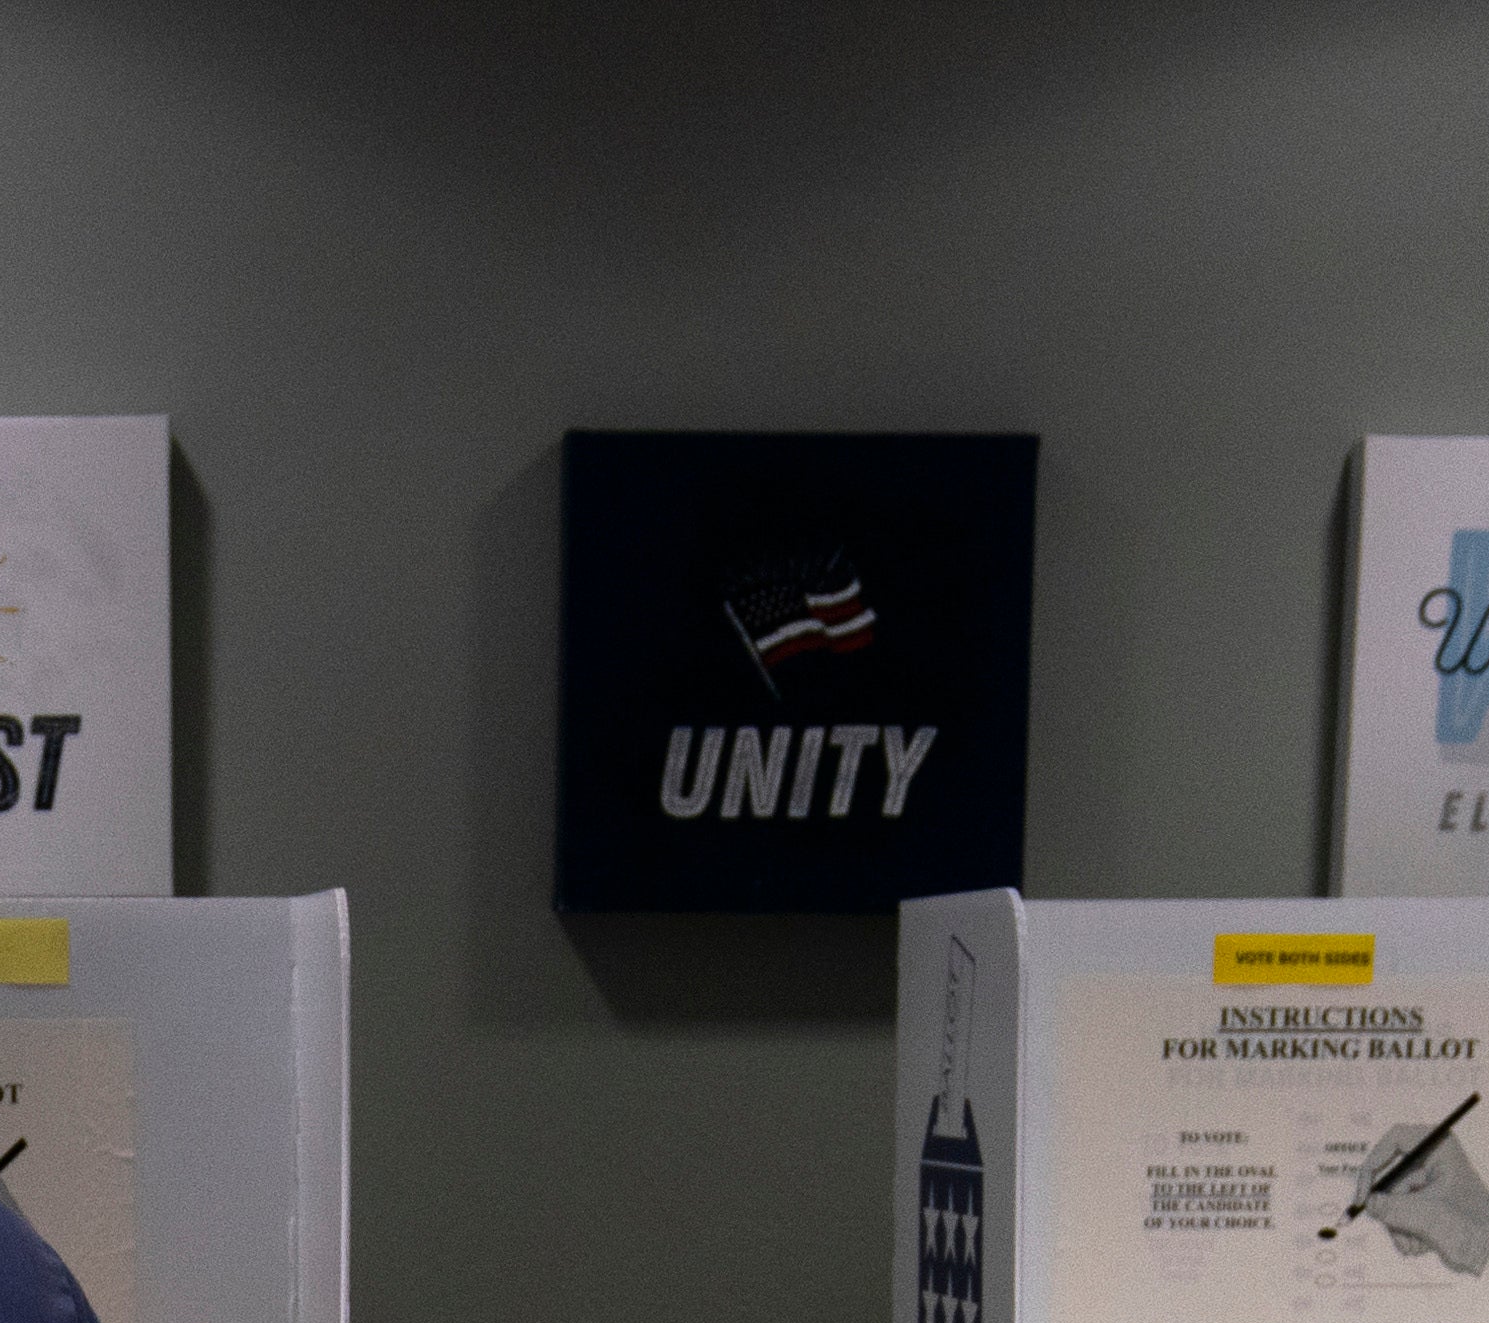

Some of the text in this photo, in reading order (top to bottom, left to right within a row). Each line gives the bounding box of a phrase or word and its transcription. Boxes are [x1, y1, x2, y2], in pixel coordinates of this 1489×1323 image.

[660, 724, 938, 819] UNITY
[1235, 951, 1370, 967] VOTE BOTH SIDES
[1218, 1005, 1424, 1033] INSTRUCTIONS
[1163, 1037, 1479, 1060] FOR MARKING BALLOT
[1179, 1131, 1200, 1144] TO
[1146, 1165, 1278, 1179] FILL IN THE OVAL
[1152, 1182, 1271, 1197] TO THE LEFT OF
[1152, 1199, 1269, 1212] THE CANDIDATE
[1142, 1216, 1163, 1229] OF
[1167, 1216, 1210, 1229] YOUR
